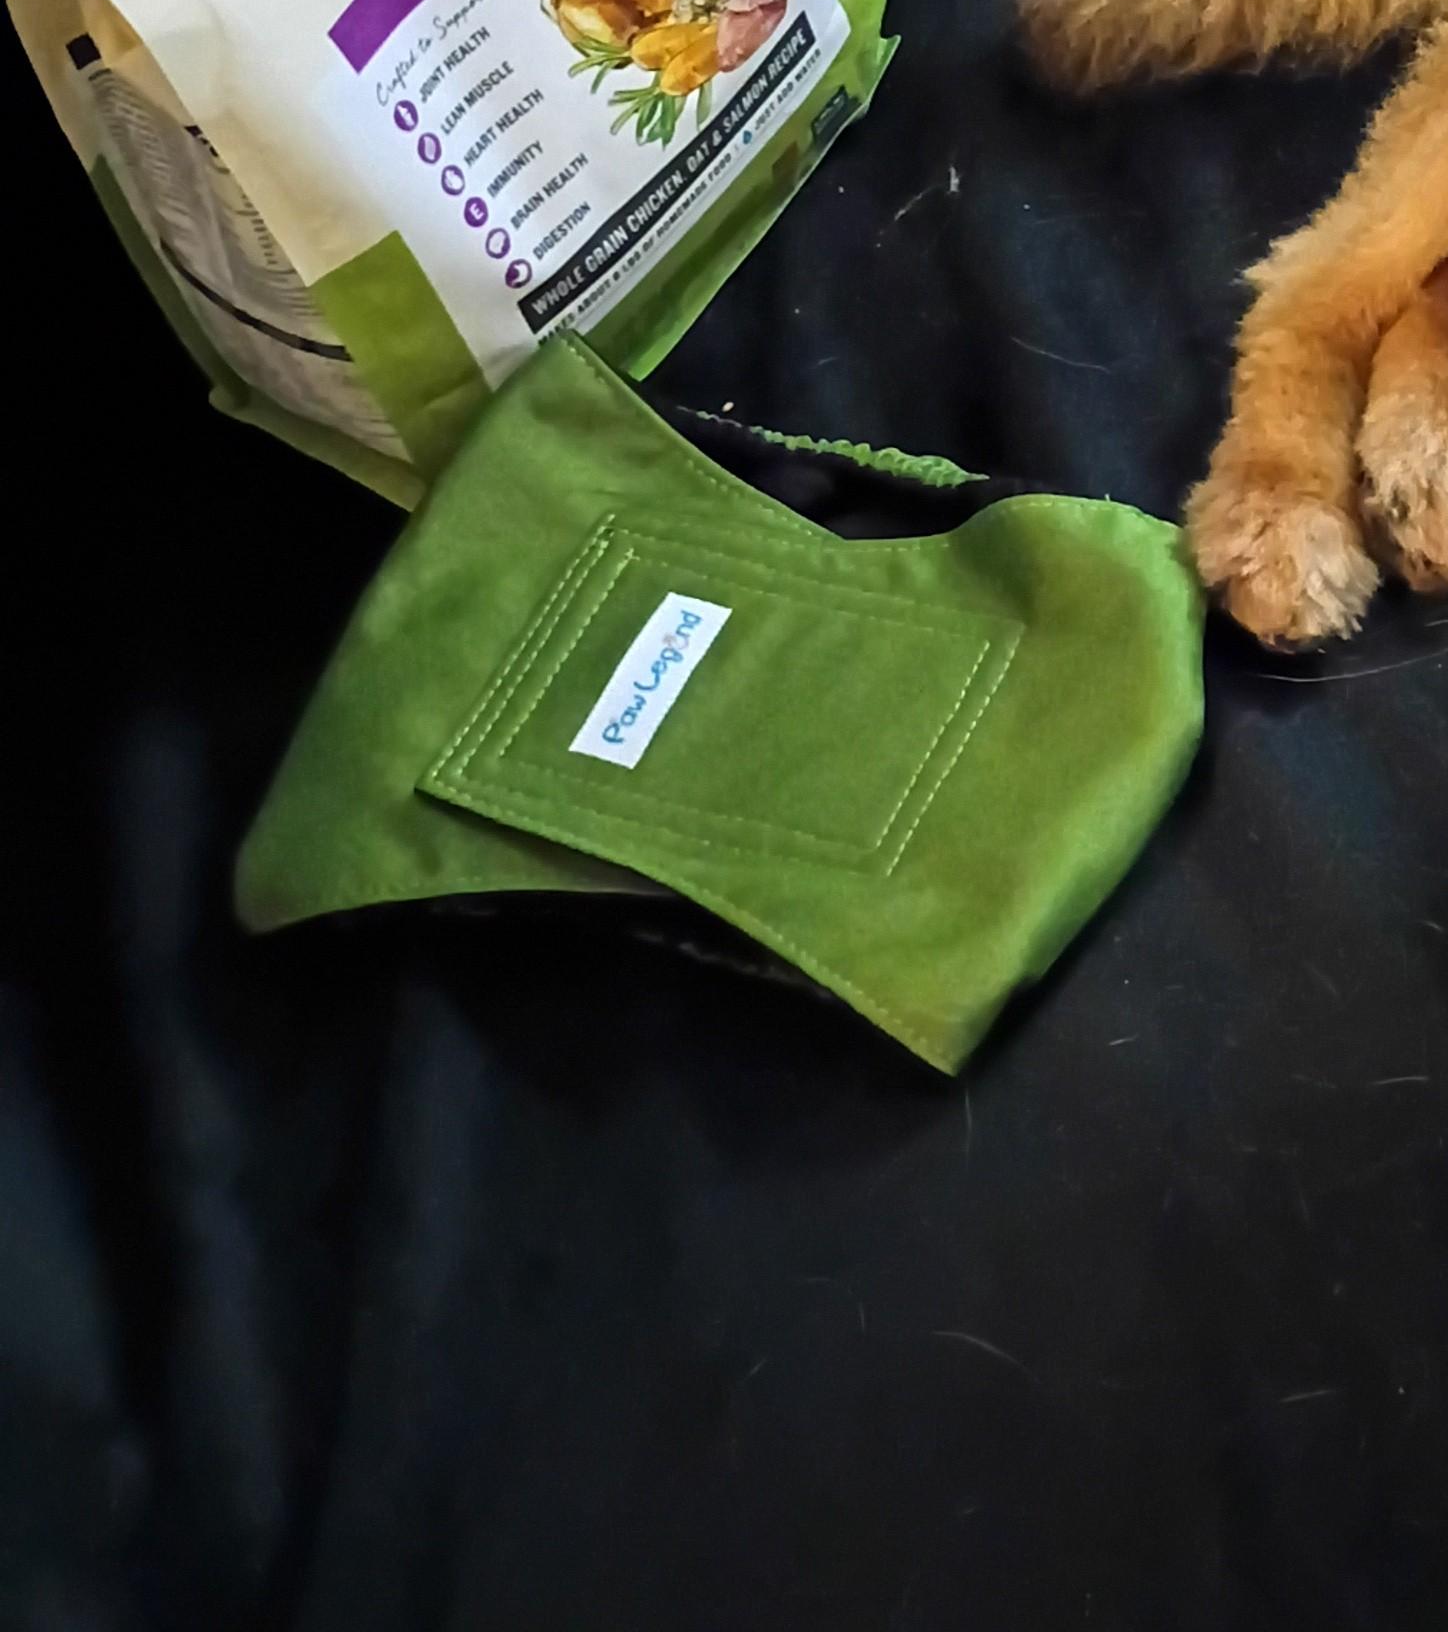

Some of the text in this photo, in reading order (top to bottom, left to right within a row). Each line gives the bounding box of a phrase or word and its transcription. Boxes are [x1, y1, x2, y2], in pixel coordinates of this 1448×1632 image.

[376, 49, 417, 107] Crafted
[418, 37, 432, 52] to
[419, 26, 491, 103] JOINT HEALTH
[440, 60, 514, 135] LEAN MUSCLE
[754, 48, 822, 131] JUST ADD WATER
[464, 88, 544, 168] HEART HEALTH
[487, 140, 544, 198] IMMUNITY
[510, 152, 589, 230] BRAIN HEALTH
[531, 266, 585, 315] WHOLE
[584, 226, 629, 272] GRAIN
[686, 141, 711, 173] OAT
[712, 129, 722, 146] &
[723, 75, 769, 133] SALMON
[767, 28, 808, 80] RECIPE
[532, 202, 591, 260] DIGESTION
[577, 279, 612, 314] ABOUT
[657, 181, 708, 238] HOMEMADE
[708, 152, 732, 182] FOOD
[602, 694, 647, 744] Paw
